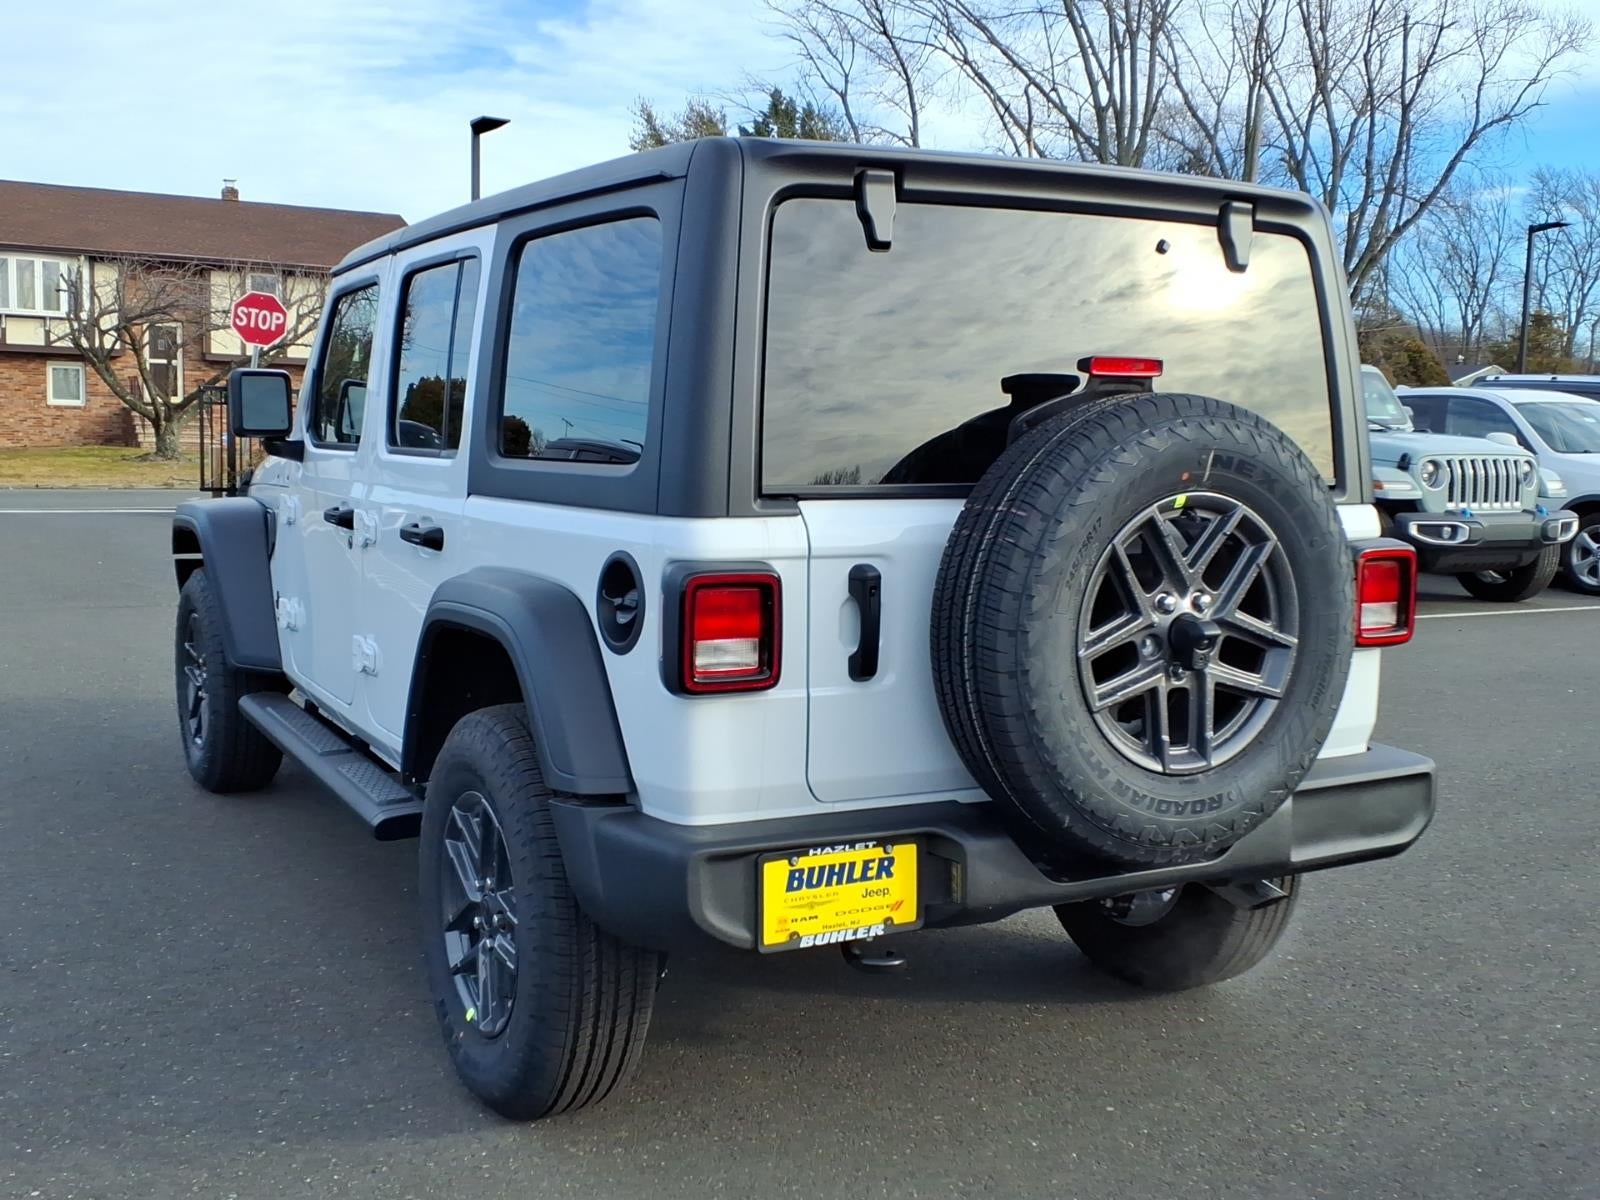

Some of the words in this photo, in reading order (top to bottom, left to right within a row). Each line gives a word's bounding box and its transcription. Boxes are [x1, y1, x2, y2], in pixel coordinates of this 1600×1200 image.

[235, 306, 284, 331] STOP
[1110, 778, 1224, 816] ROADIAN
[809, 841, 877, 856] HAZLET
[785, 856, 895, 893] BUHLER
[784, 892, 839, 904] CHRYSLER
[861, 887, 890, 899] Jeep
[791, 915, 819, 923] RAM
[799, 923, 885, 948] BUHLER
